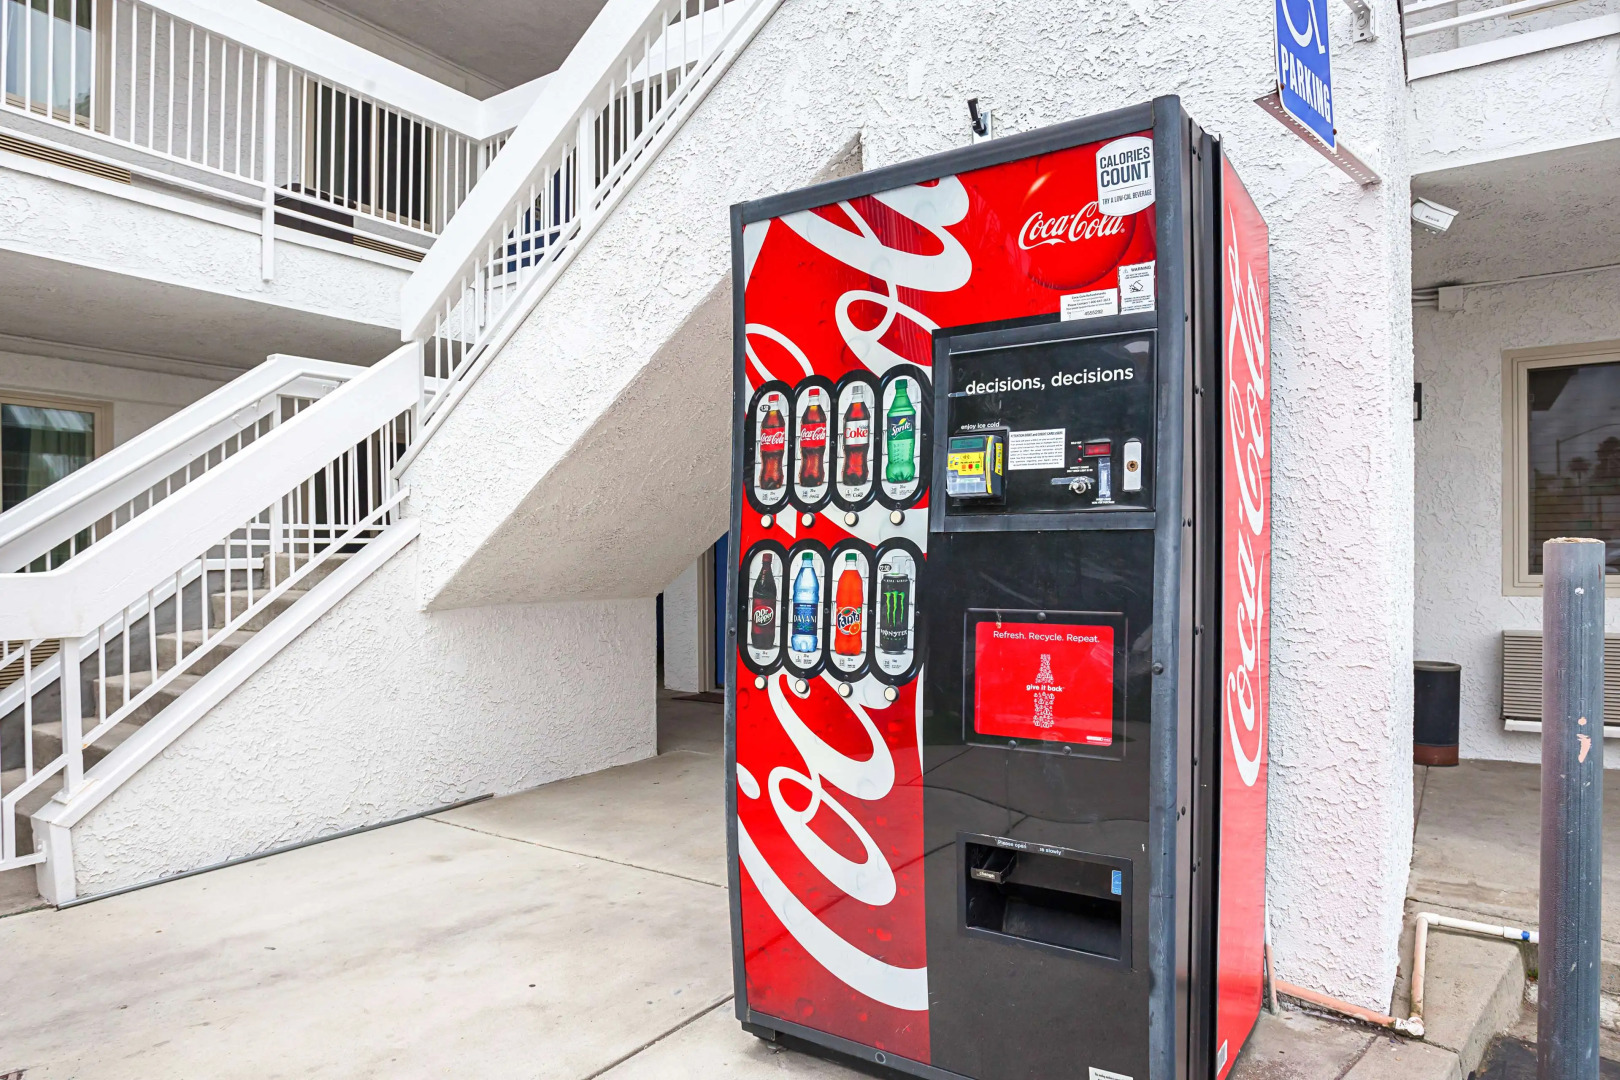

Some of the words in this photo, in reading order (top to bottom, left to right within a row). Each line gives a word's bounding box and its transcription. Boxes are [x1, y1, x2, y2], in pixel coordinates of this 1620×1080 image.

[1280, 43, 1332, 125] PARKING
[1100, 146, 1151, 169] CALORIES
[1100, 160, 1151, 188] COUNT
[1102, 197, 1111, 206] TRY
[1133, 189, 1152, 199] BEVERAGE
[1018, 200, 1124, 250] Coca-Cola
[965, 376, 1046, 395] decisions,
[1051, 367, 1134, 387] decisions
[801, 426, 826, 441] Coca-Cola
[844, 427, 868, 438] Coke
[891, 421, 912, 437] Sprite
[761, 431, 785, 446] Coca-Cola
[1227, 203, 1265, 787] Coca-Cola
[754, 611, 774, 624] Pepper
[760, 608, 769, 617] Dr
[793, 614, 817, 624] DASANI
[880, 628, 909, 638] MONSTER
[993, 630, 1027, 640] Refresh.
[1028, 632, 1064, 642] Recycle.
[1066, 633, 1100, 643] Repeat.
[1047, 684, 1063, 692] back
[997, 839, 1014, 847] Please
[1014, 842, 1027, 850] open
[1045, 848, 1062, 856] slowly
